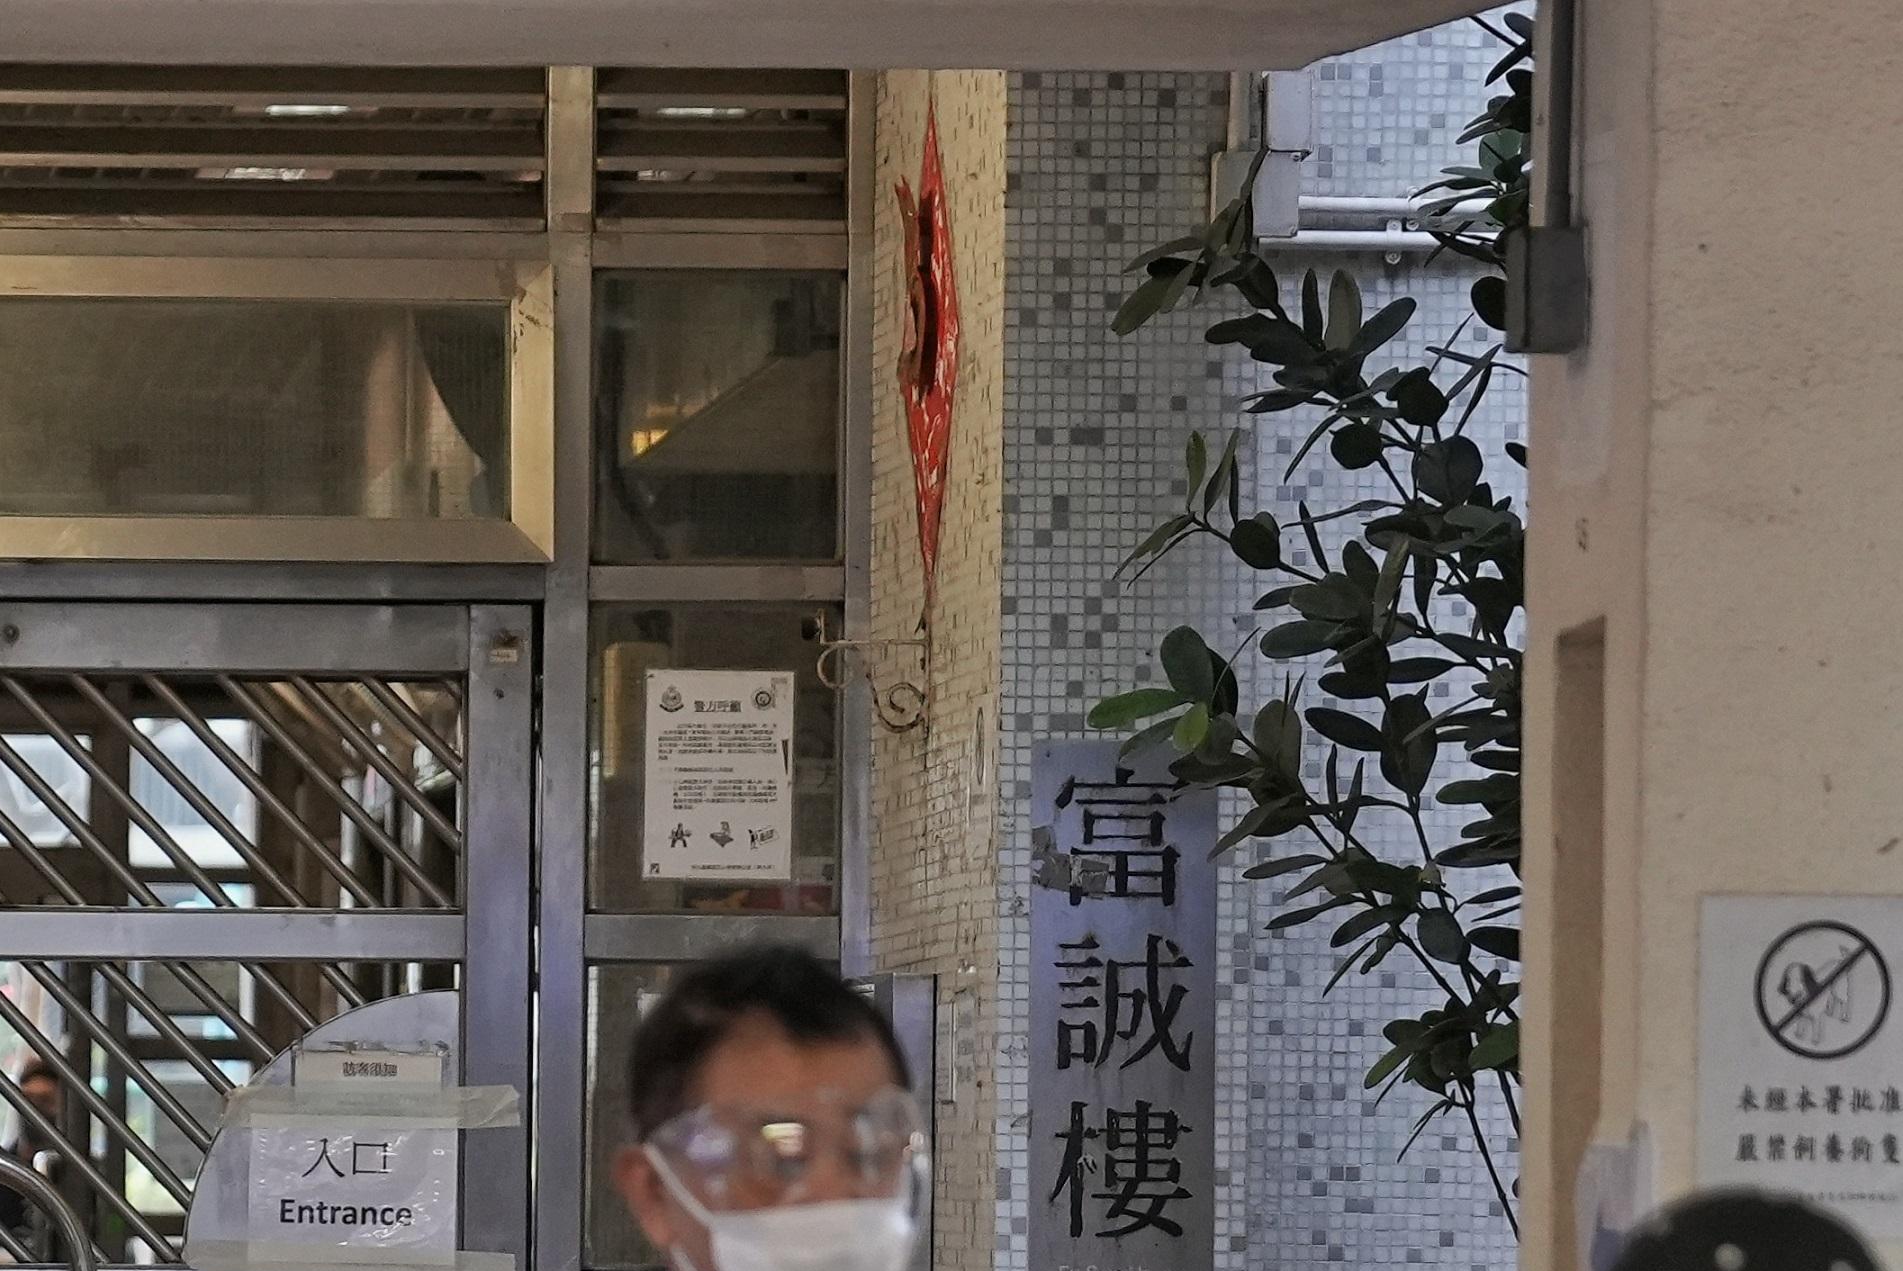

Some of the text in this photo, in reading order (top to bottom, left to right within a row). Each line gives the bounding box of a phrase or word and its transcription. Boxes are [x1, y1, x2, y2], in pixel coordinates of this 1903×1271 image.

[1050, 768, 1194, 1240] 富誠樓
[302, 1138, 390, 1178] 入口
[279, 1198, 413, 1228] Entrance
